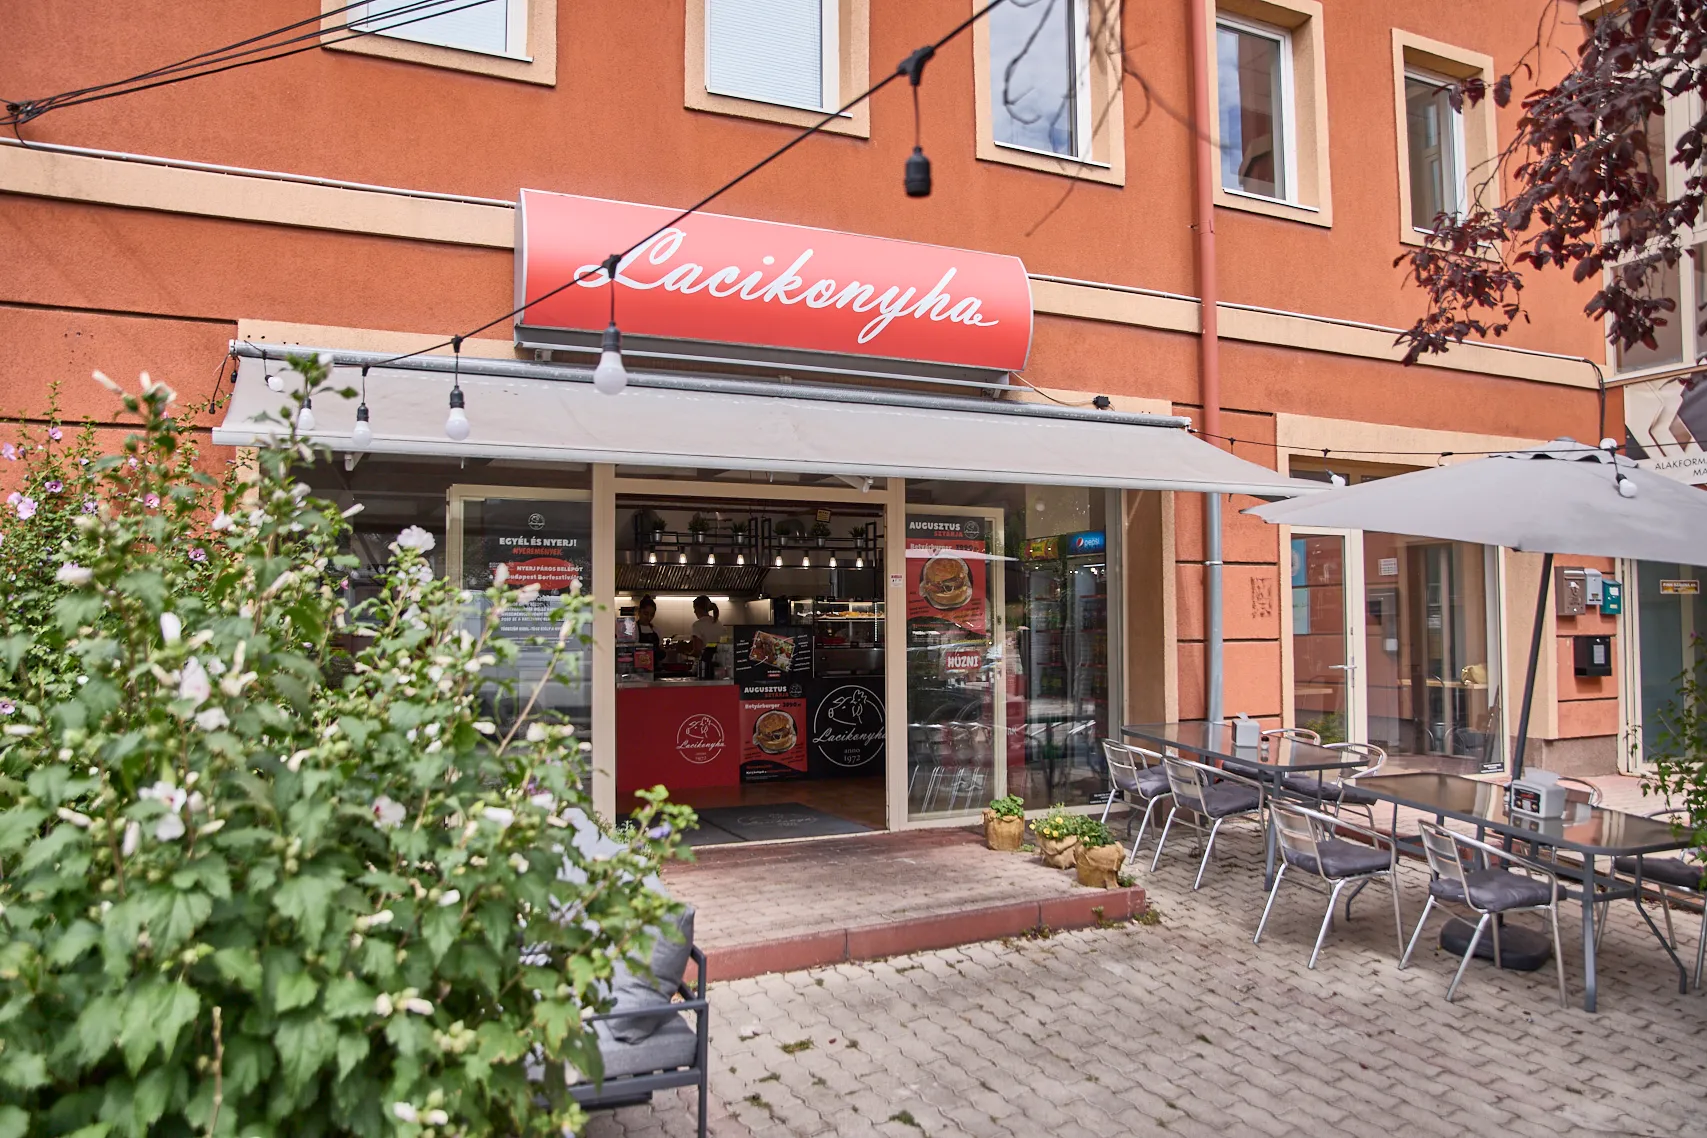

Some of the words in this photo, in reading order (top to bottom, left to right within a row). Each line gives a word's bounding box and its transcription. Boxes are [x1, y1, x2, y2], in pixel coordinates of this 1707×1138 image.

[573, 227, 999, 344] Lacikonyha
[1655, 457, 1707, 470] ALAKFORM
[909, 521, 961, 531] AUGUSZTUS
[499, 536, 529, 546] EGYÉL
[530, 535, 542, 546] ÉS
[543, 538, 577, 547] NYERJ!
[947, 653, 979, 668] HÚZNI
[676, 739, 726, 751] Lacikonyha
[843, 755, 861, 763] 1972
